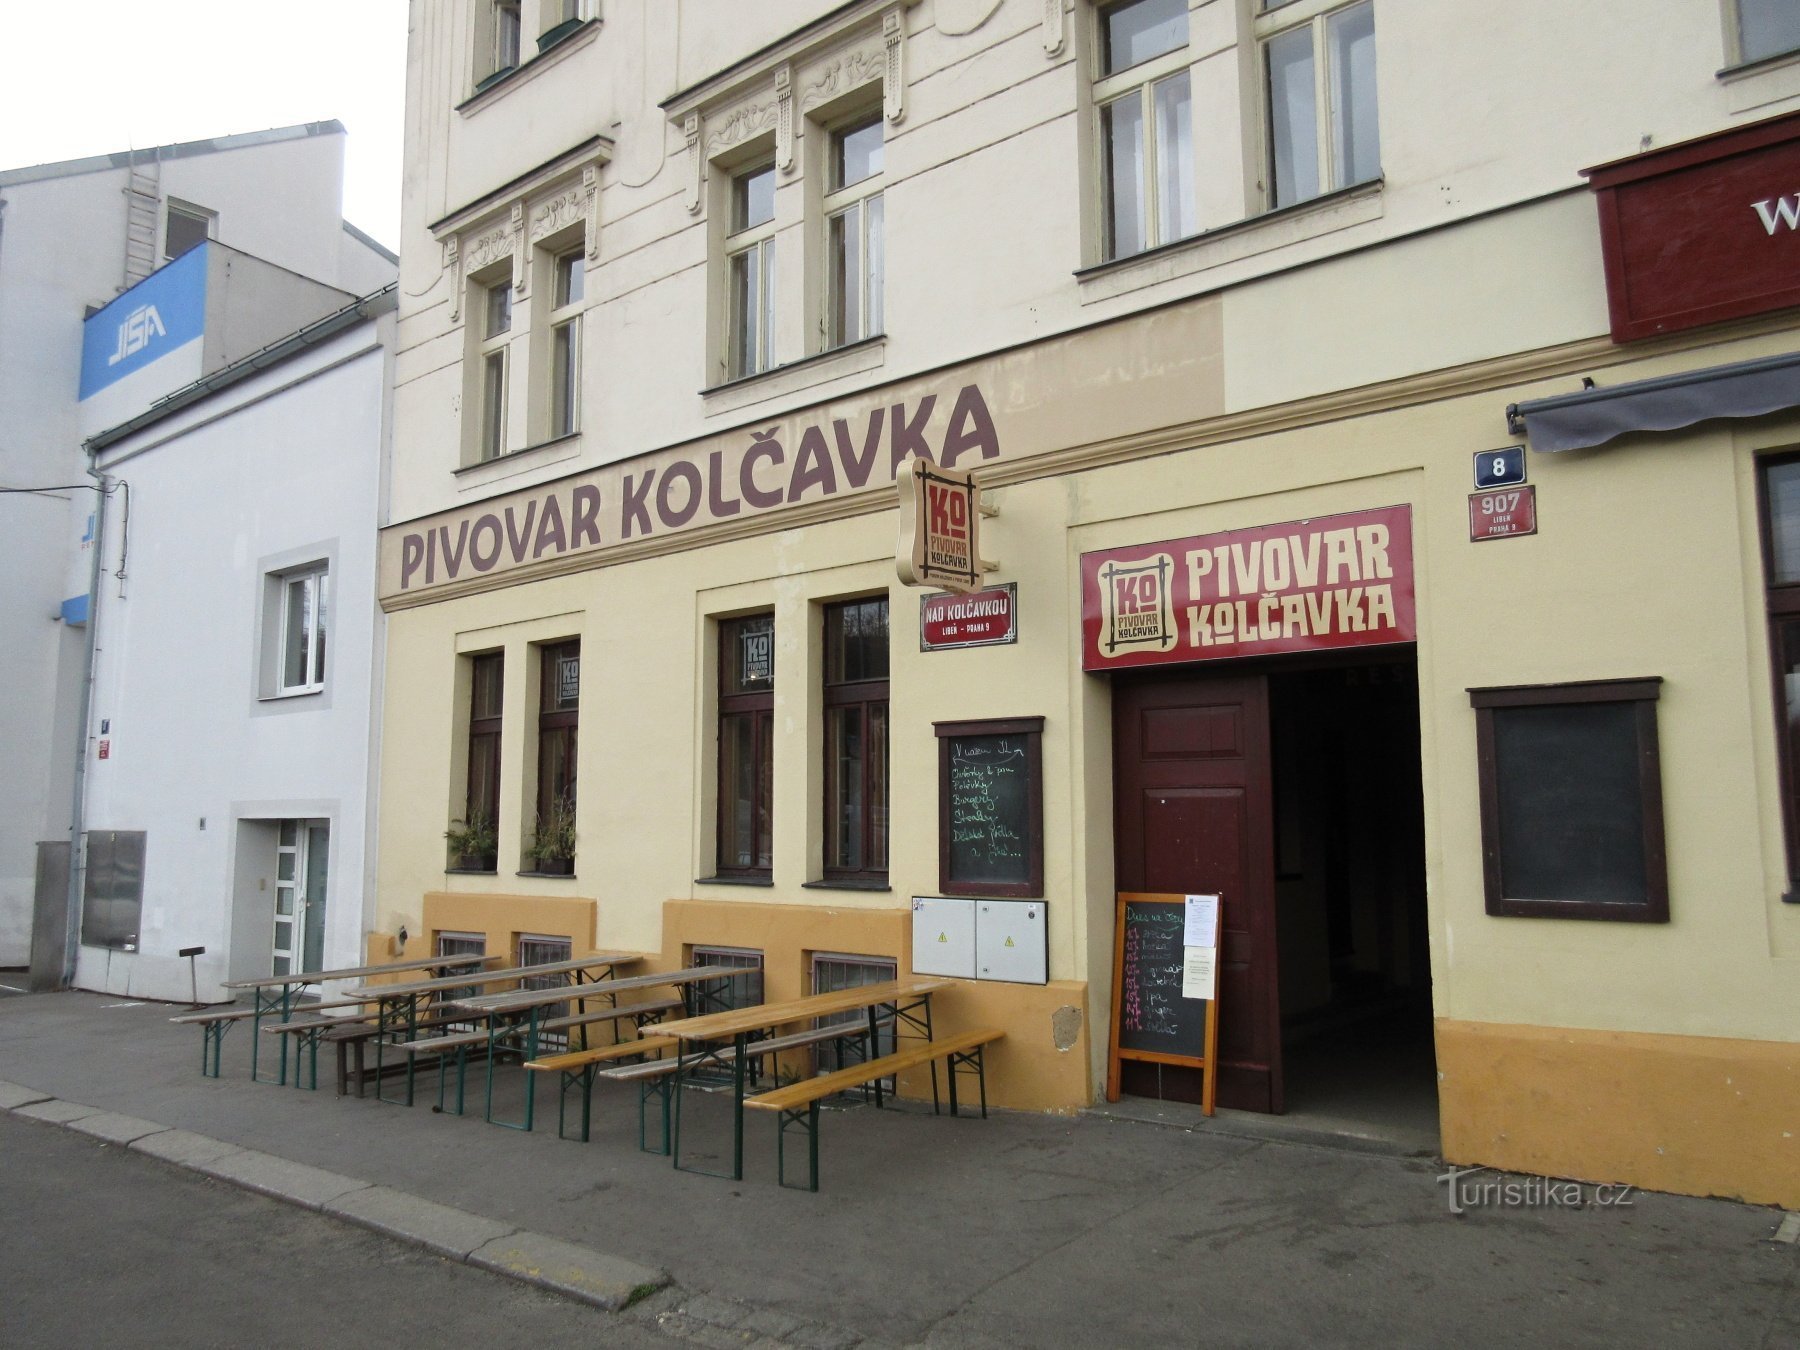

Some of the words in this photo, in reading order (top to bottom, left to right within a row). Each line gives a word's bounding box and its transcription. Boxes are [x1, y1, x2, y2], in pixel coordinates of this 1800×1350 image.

[109, 304, 167, 367] JISA
[1492, 457, 1506, 477] 8
[401, 484, 601, 590] PIVOVAR
[621, 384, 1000, 540] KOLČAVKA
[929, 484, 966, 540] KO
[1481, 492, 1520, 515] 907
[931, 536, 968, 557] PIVOVAR
[1185, 523, 1393, 601] PIVOVAR
[1116, 574, 1157, 616] KO
[926, 604, 945, 624] NAD
[947, 599, 1008, 622] KOLČAVKOU
[1118, 613, 1159, 629] PIVOVAR
[1186, 583, 1396, 648] KOLČAVKA
[966, 623, 985, 633] PRAHA
[985, 622, 990, 632] 9
[747, 636, 768, 662] KO
